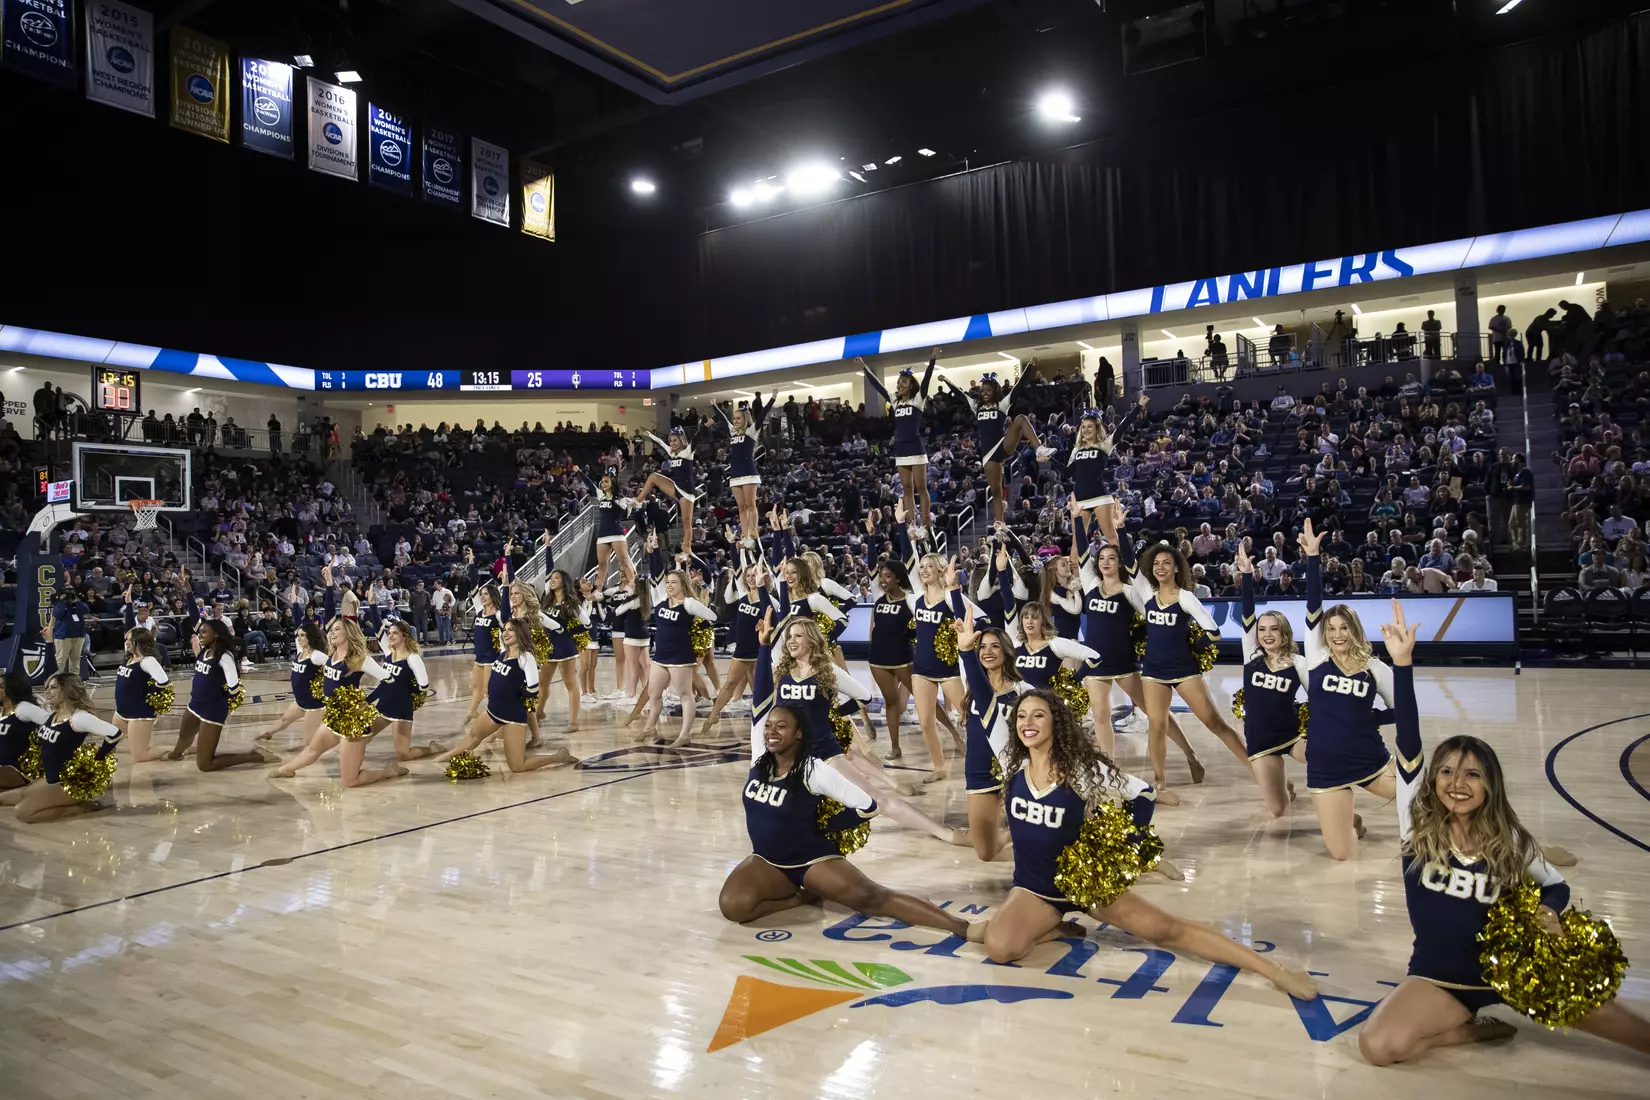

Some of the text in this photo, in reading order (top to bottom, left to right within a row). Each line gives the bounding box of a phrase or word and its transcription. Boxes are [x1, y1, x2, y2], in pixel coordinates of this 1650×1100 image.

[101, 4, 138, 27] 2015
[95, 17, 142, 39] WOMEN'S
[90, 25, 152, 53] BASKETBALL
[5, 39, 73, 69] CHAMPIONS
[182, 37, 216, 58] 2015
[92, 68, 151, 93] WEST REGION
[94, 78, 148, 100] CHAMPIONS
[190, 86, 213, 99] NCAA
[242, 80, 290, 102] BASKETBALL
[318, 88, 345, 105] 2016
[176, 98, 216, 117] DIVISION
[314, 100, 348, 116] WOMEN'S
[174, 115, 212, 131] RUNNER
[177, 108, 223, 127] NATIONAL
[311, 106, 354, 126] BASKETBALL
[378, 108, 403, 124] 2017
[243, 122, 290, 143] CHAMPIONS
[371, 125, 411, 144] BASKETBALL
[373, 118, 405, 135] WOMEN'S
[325, 131, 342, 141] NCAA
[431, 129, 454, 144] 2017
[311, 149, 356, 167] TOURNAMENT
[317, 144, 344, 157] DIVISION
[480, 147, 501, 160] 2017
[371, 163, 410, 180] CHAMPIONS
[427, 188, 459, 204] CHAMPIONS
[365, 371, 542, 388] CBU 48 13:15 25
[104, 386, 130, 409] 30
[3, 407, 26, 415] ERVE
[894, 407, 913, 416] CBU
[977, 410, 998, 420] CBU
[730, 435, 745, 444] CBU
[1075, 450, 1098, 460] CBU
[657, 607, 680, 621] CBU
[738, 603, 760, 617] CBU
[876, 603, 901, 615] CBU
[1088, 598, 1119, 614] CBU
[474, 617, 492, 627] CBU
[915, 608, 943, 624] CBU
[1147, 610, 1178, 626] CBU
[195, 660, 211, 675] CBU
[291, 662, 306, 673] CBU
[382, 662, 402, 676] CBU
[491, 659, 512, 676] CBU
[1015, 655, 1047, 669] CBU
[116, 665, 133, 678] CBU
[323, 666, 342, 681] CBU
[1251, 671, 1292, 693] CBU
[1322, 674, 1370, 698] CBU
[780, 685, 817, 700] CBU
[38, 725, 61, 743] CBU
[744, 779, 788, 808] CBU
[1010, 796, 1066, 829] CBU
[1420, 860, 1501, 904] CBU
